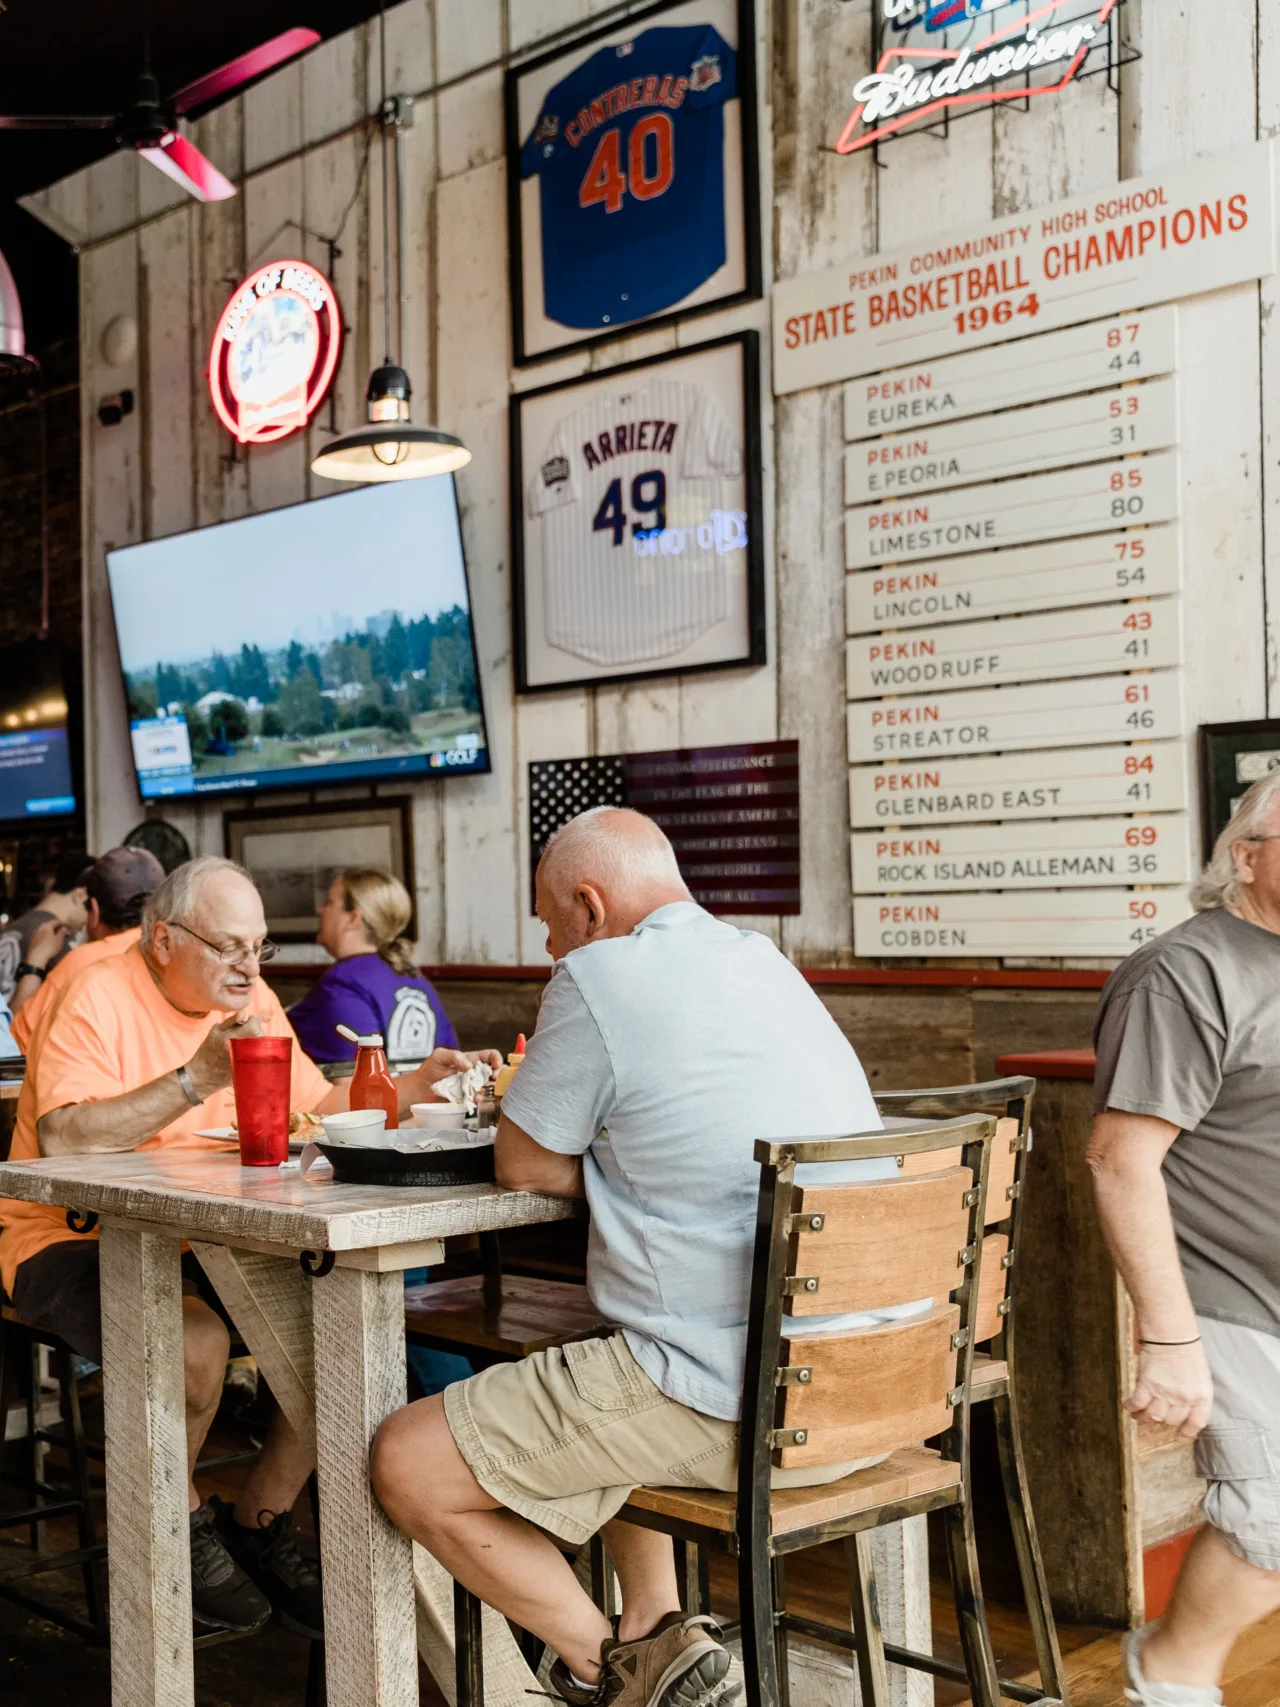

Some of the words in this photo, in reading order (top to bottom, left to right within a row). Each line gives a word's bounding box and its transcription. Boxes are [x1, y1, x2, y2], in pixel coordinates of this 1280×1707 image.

[852, 23, 1096, 123] Budweiser
[564, 74, 688, 147] CONTRERAS
[578, 111, 674, 213] 40
[848, 263, 898, 292] PEKIN
[909, 223, 1031, 275] COMMUNITY
[1041, 208, 1087, 238] HIGH
[1094, 185, 1168, 224] SCHOOL
[784, 301, 856, 350] STATE
[868, 255, 1029, 329] BASKETBALL
[1043, 194, 1248, 280] CHAMPIONS
[952, 292, 1040, 336] 1964
[867, 373, 932, 402] PEKIN
[1106, 323, 1140, 348] 87
[867, 393, 956, 427] EUREKA
[1108, 350, 1141, 372] 44
[582, 420, 678, 471] ARRIETA
[867, 440, 929, 467] PEKIN
[1109, 396, 1140, 419] 53
[884, 458, 960, 488] PEORIA
[1110, 424, 1137, 446] 31
[592, 470, 667, 547] 49
[868, 506, 929, 533] PEKIN
[1109, 468, 1143, 492] 85
[869, 519, 996, 557] LIMESTONE
[1110, 496, 1144, 519] 80
[873, 571, 938, 597] PEKIN
[1114, 539, 1145, 560] 75
[873, 592, 971, 620] LINCOLN
[1115, 567, 1145, 588] 54
[869, 639, 935, 663] PEKIN
[1122, 611, 1152, 631] 43
[871, 655, 1000, 687] WOODRUFF
[1124, 638, 1150, 658] 41
[871, 705, 940, 728] PEKIN
[1124, 684, 1149, 704] 61
[873, 725, 990, 753] STREATOR
[1126, 709, 1154, 730] 46
[874, 771, 941, 793] PEKIN
[1124, 754, 1154, 775] 84
[875, 792, 994, 817] GLENBARD
[1003, 788, 1061, 808] EAST
[1127, 782, 1152, 801] 41
[876, 838, 941, 858] PEKIN
[1125, 826, 1157, 848] 69
[877, 861, 927, 884] ROCK
[933, 859, 1005, 881] ISLAND
[1011, 855, 1115, 878] ALLEMAN
[1127, 854, 1158, 874] 36
[879, 905, 940, 924] PEKIN
[1128, 901, 1157, 920] 50
[881, 929, 966, 948] COBDEN
